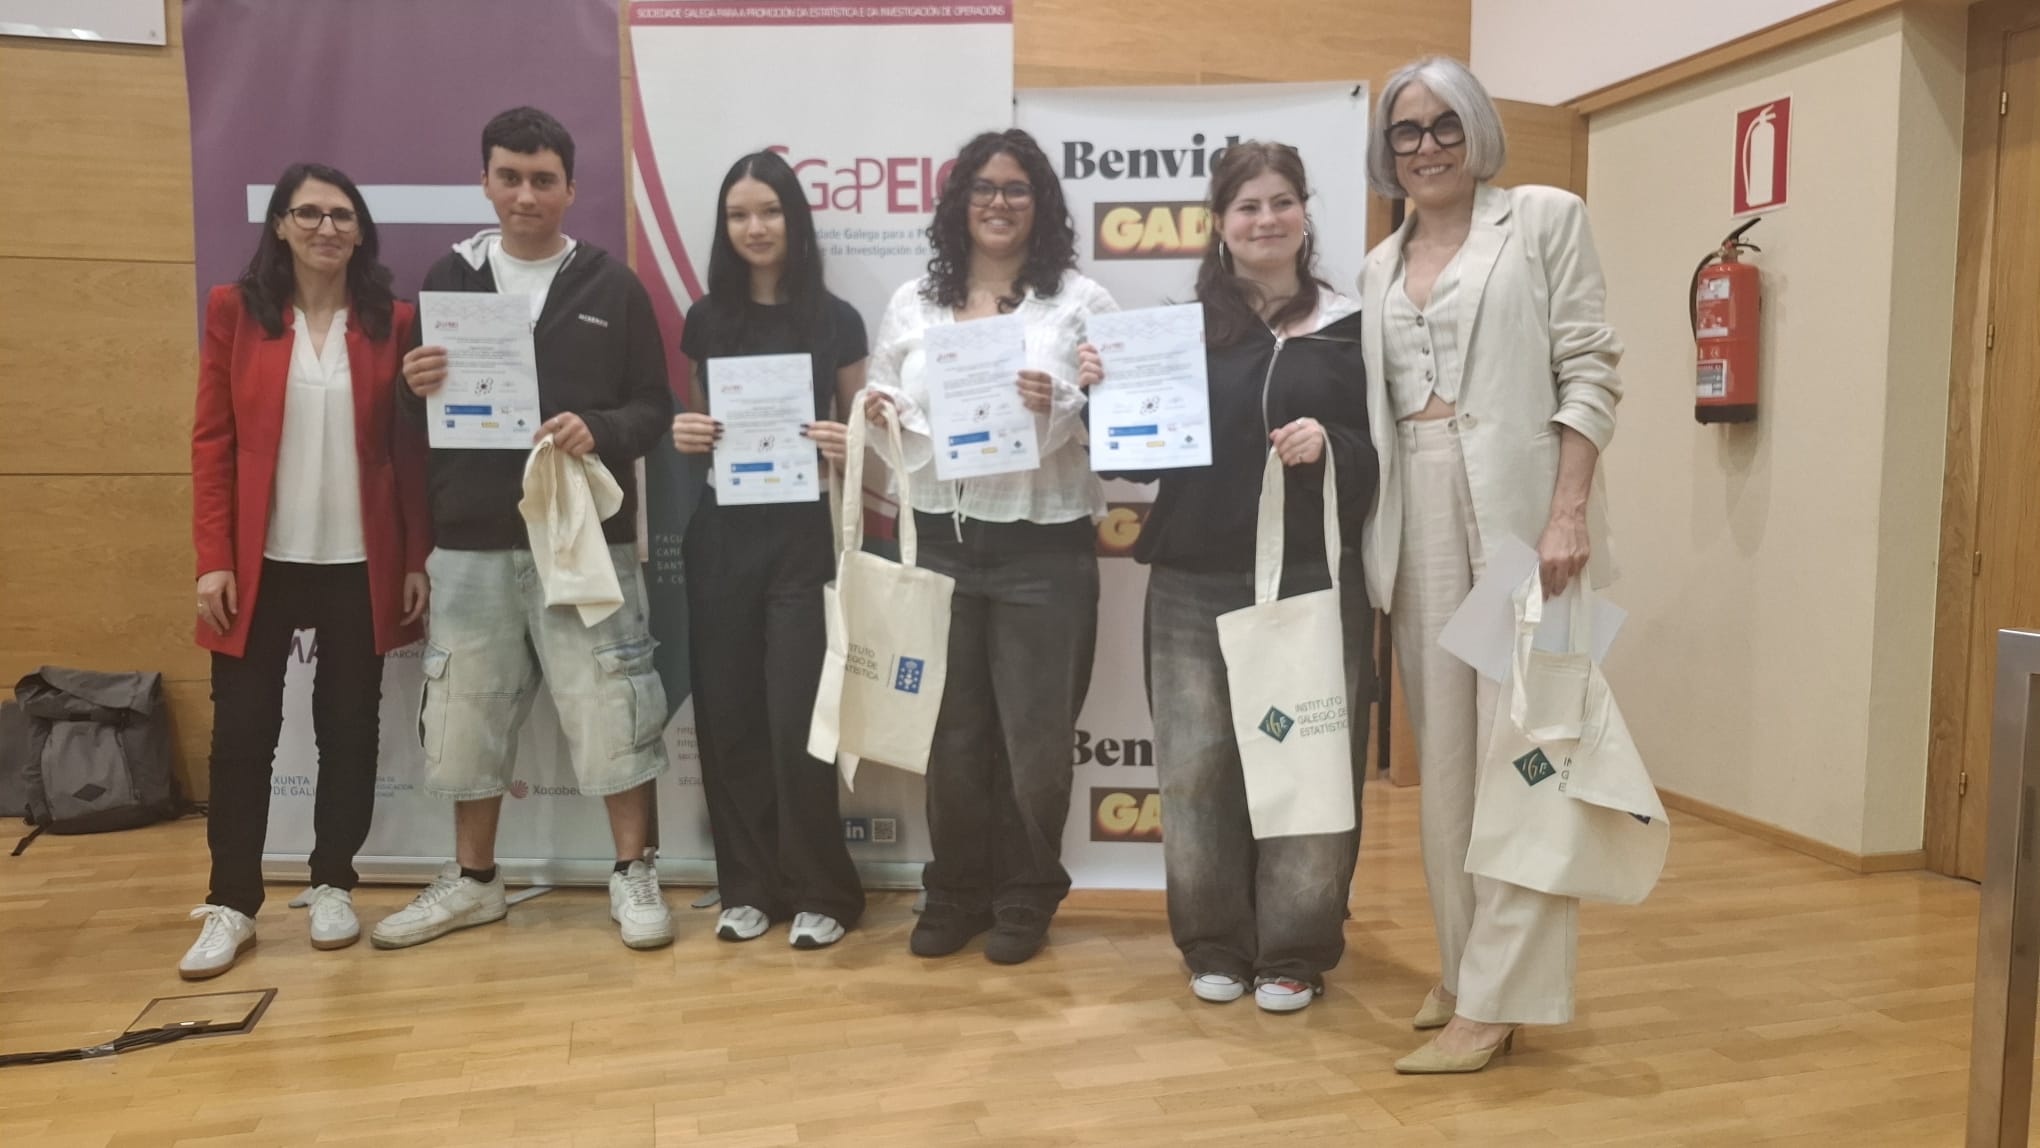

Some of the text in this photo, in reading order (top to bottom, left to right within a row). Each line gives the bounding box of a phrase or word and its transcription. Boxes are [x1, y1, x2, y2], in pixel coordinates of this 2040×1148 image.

[1101, 207, 1213, 250] GAD
[273, 775, 310, 785] XUNTA
[273, 786, 287, 796] DE
